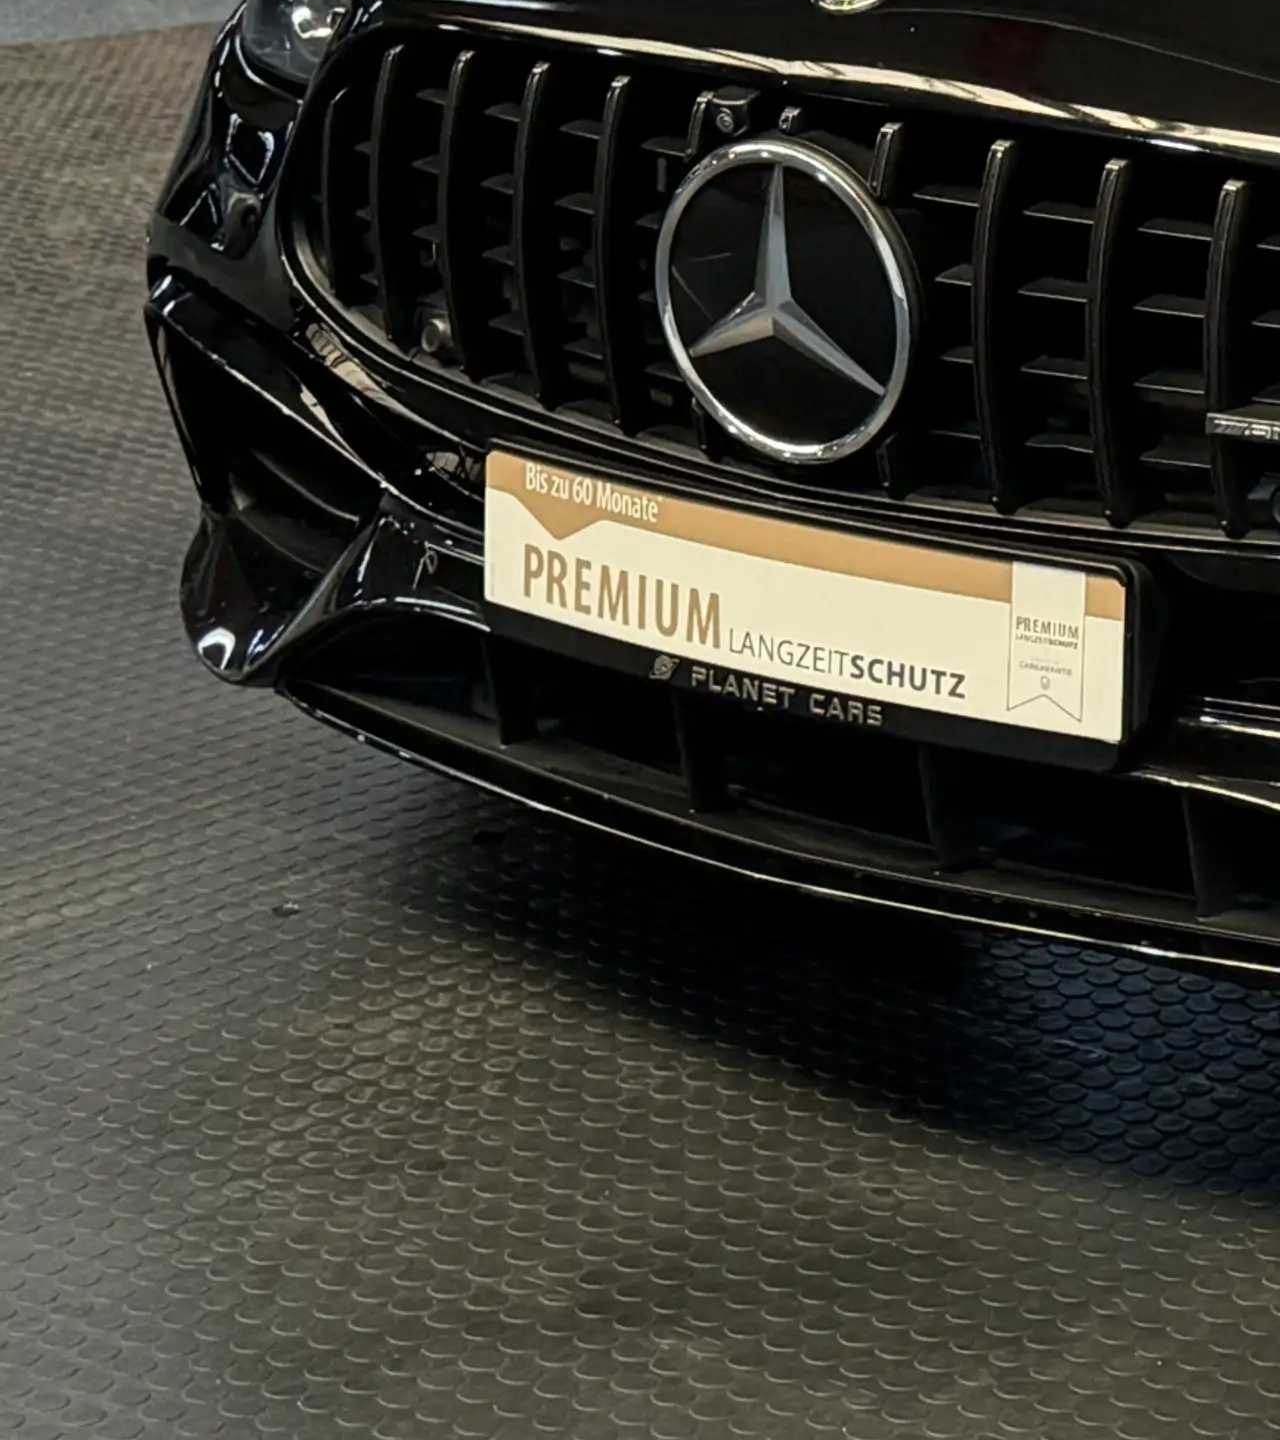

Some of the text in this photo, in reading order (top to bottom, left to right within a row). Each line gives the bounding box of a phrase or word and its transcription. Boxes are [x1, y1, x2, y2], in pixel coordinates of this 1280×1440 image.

[525, 461, 549, 494] Bis
[551, 475, 570, 501] zu
[572, 476, 593, 506] 60
[523, 543, 967, 700] PREMIUM LANGZEITSCHUTZ
[1015, 615, 1080, 641] PREMIUM
[691, 665, 884, 727] PLANET CARS
